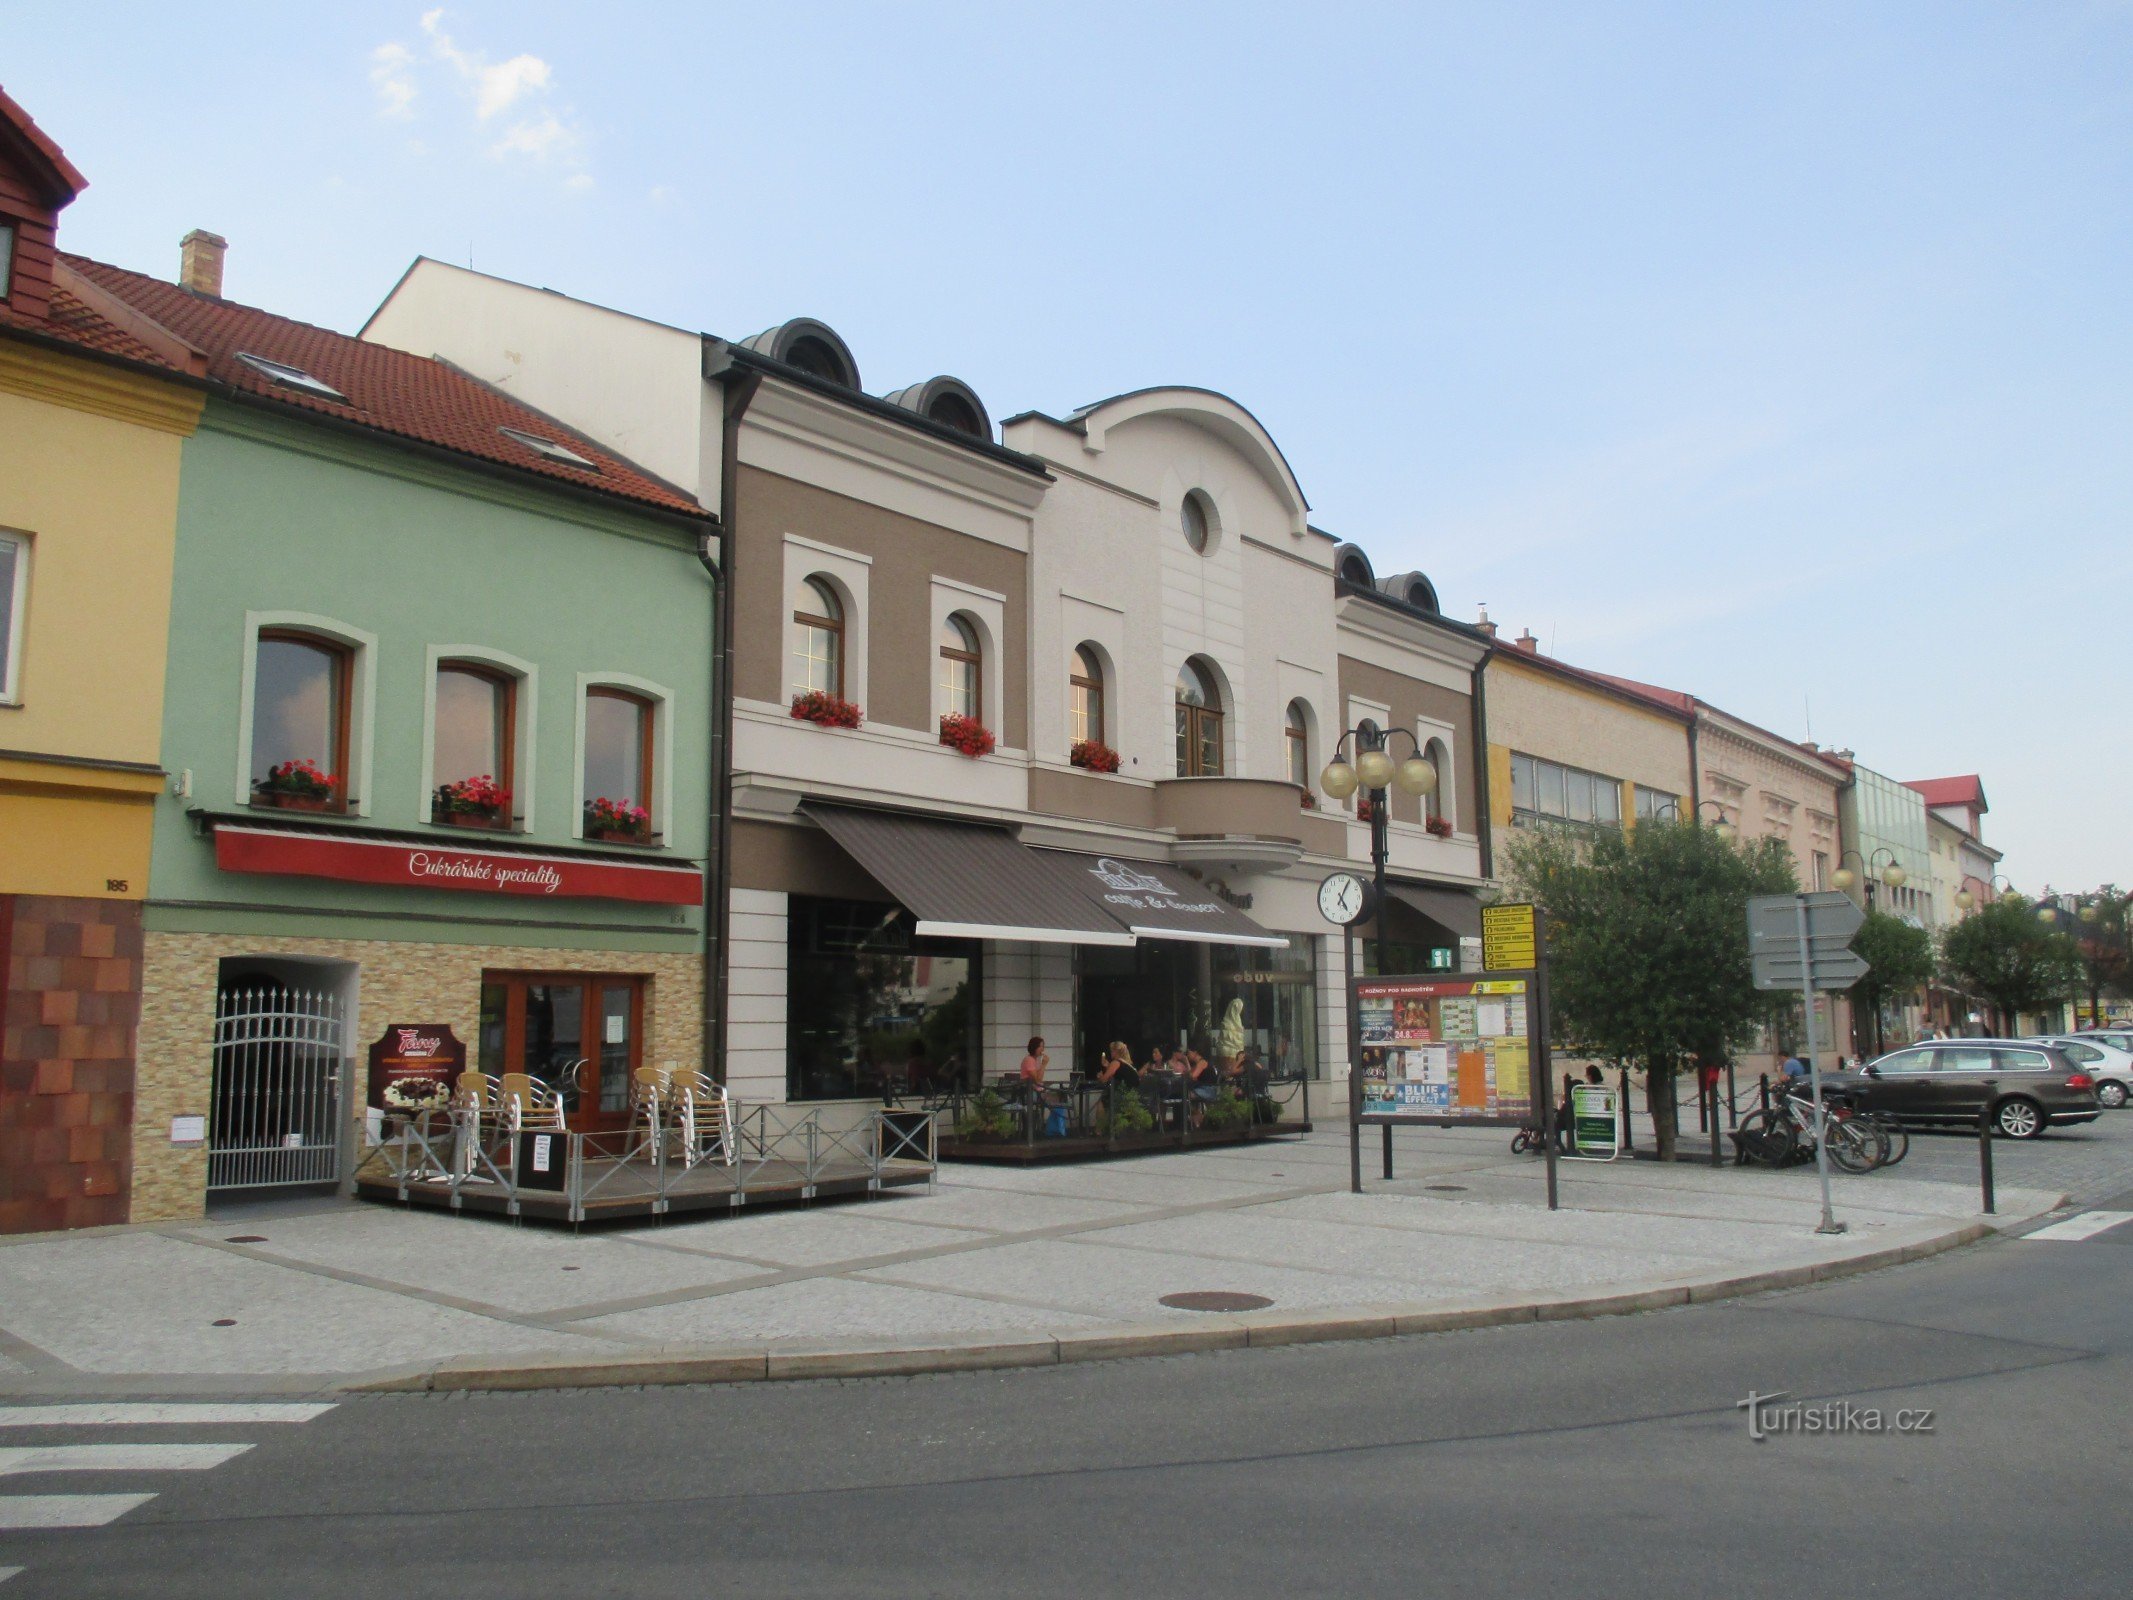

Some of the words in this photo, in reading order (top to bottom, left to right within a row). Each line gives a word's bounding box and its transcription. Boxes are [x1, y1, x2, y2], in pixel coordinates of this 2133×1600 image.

[409, 852, 492, 880] Cukrářské
[495, 865, 562, 893] speciality
[106, 879, 128, 892] 185
[1233, 970, 1274, 983] obuv
[1404, 1084, 1439, 1096] BLUE
[1404, 1093, 1440, 1104] EFFECT
